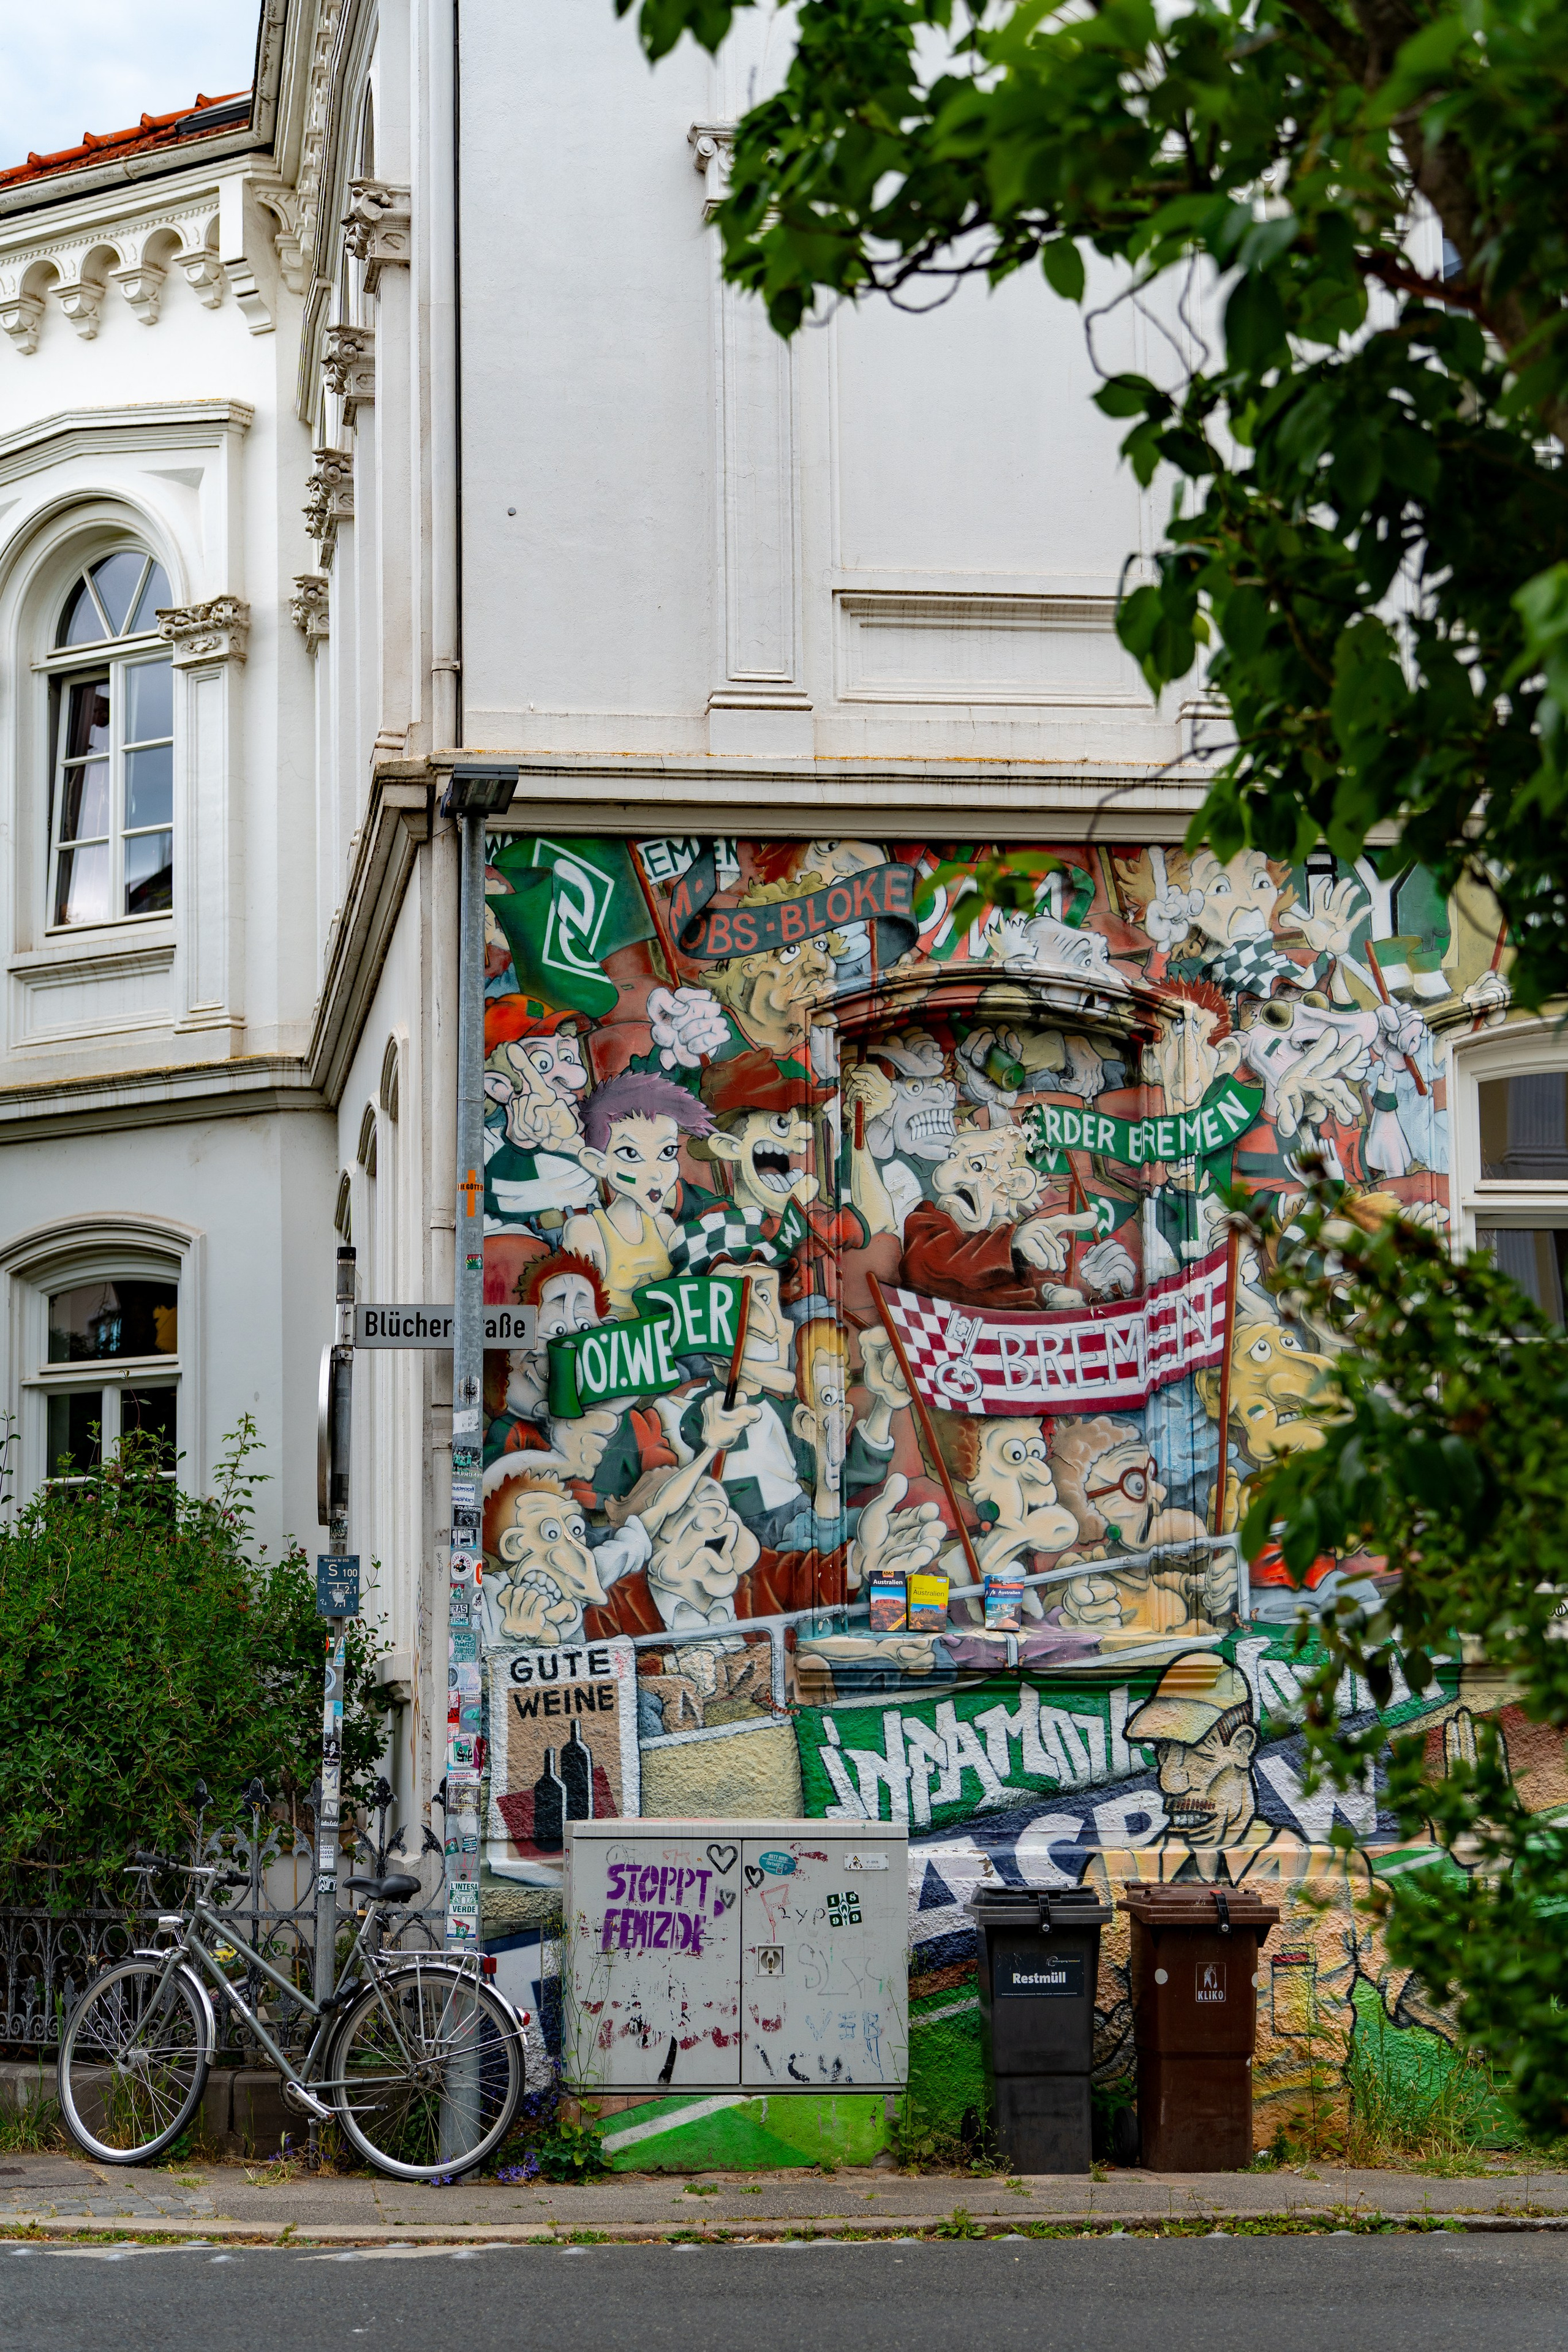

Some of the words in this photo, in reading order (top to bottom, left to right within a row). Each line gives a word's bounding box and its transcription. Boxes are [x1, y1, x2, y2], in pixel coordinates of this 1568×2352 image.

[1128, 1089, 1250, 1163] BREMEN
[365, 1310, 526, 1339] Blücheraße
[998, 1283, 1213, 1391] BREMEN
[328, 1564, 338, 1577] S
[343, 1569, 358, 1577] 100
[510, 1648, 611, 1683] GUTE
[514, 1684, 614, 1719] WEINE
[606, 1863, 713, 1909] STOPPT
[601, 1908, 707, 1953] FEMIZIDE
[1012, 1972, 1066, 1984] Restmüll
[1197, 1990, 1224, 2000] KLIKO
